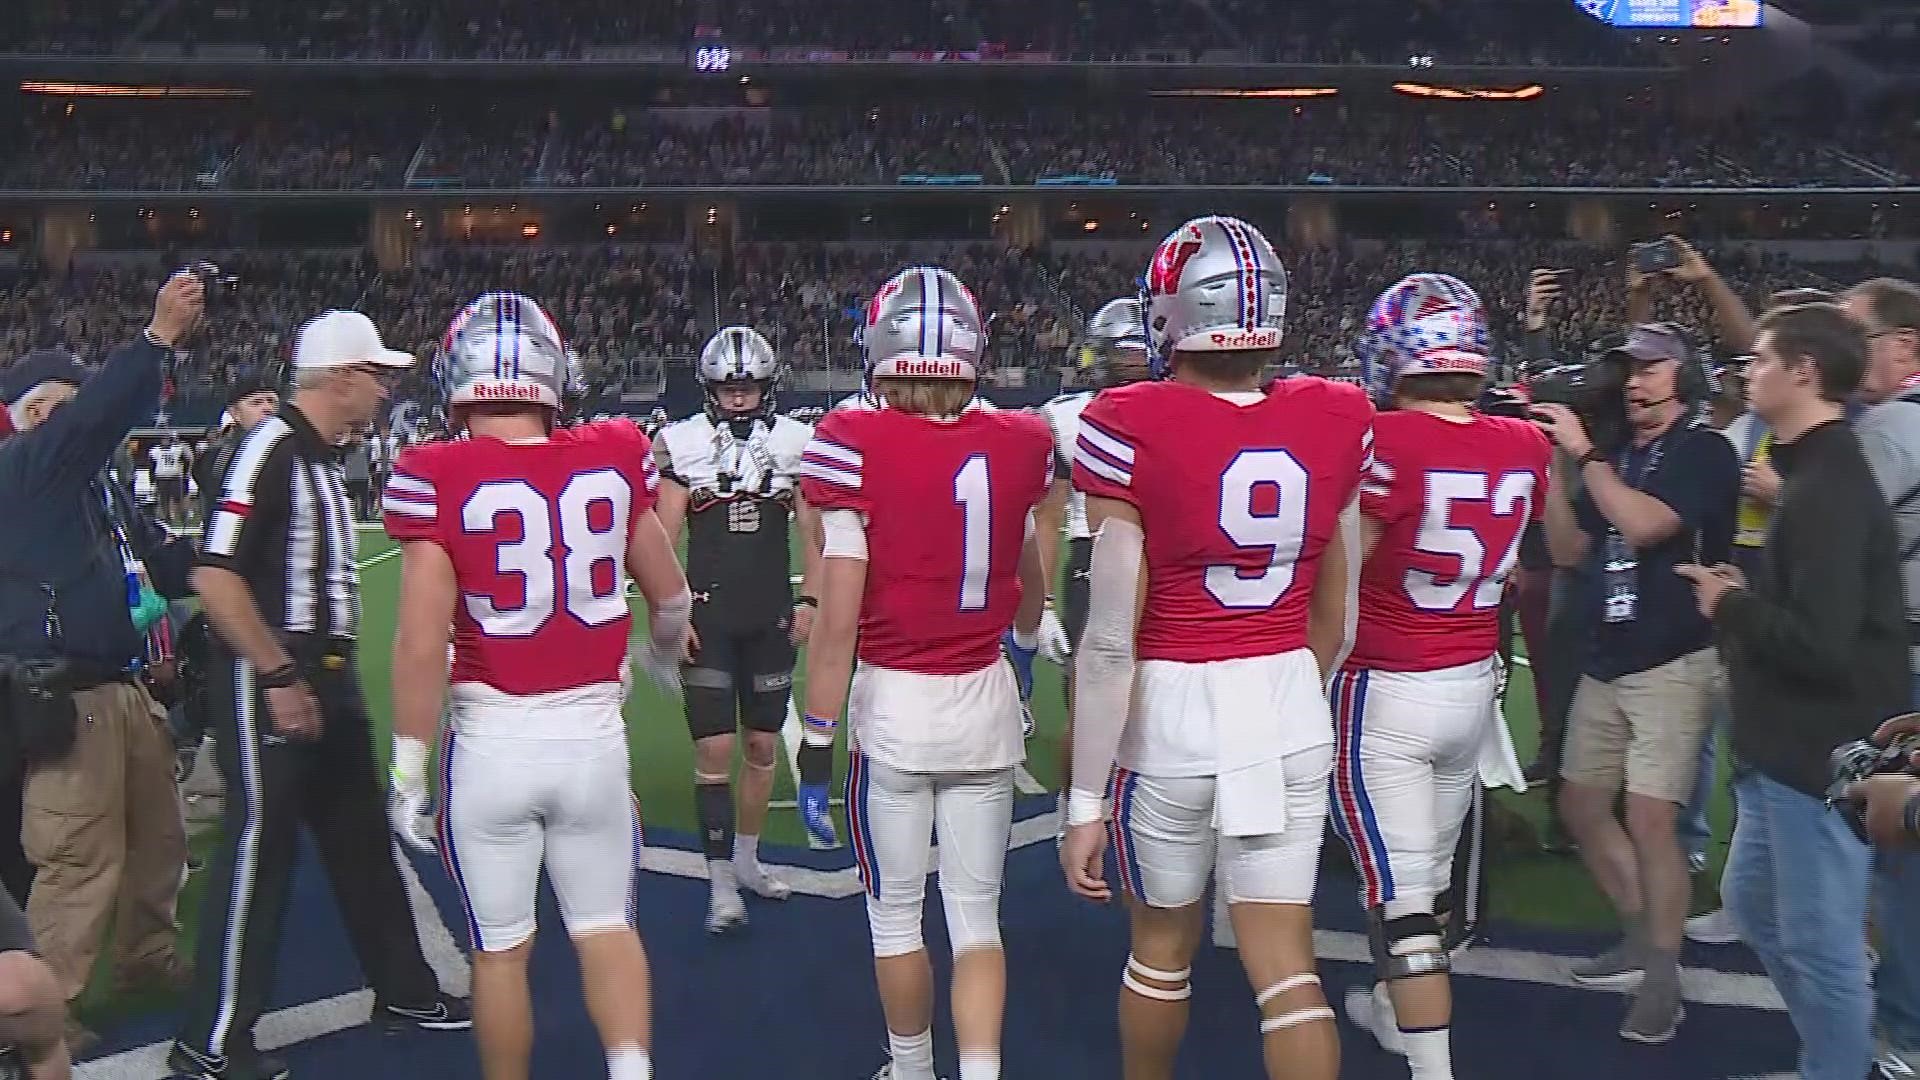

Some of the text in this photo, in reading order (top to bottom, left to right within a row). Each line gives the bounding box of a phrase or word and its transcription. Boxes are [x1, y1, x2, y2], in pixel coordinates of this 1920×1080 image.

[474, 381, 540, 400] Riddell
[895, 360, 961, 376] Riddell
[1211, 332, 1276, 347] Riddell
[460, 467, 634, 639] 38
[953, 453, 992, 613] 1
[1203, 448, 1311, 610] 9
[1402, 468, 1536, 611] 52
